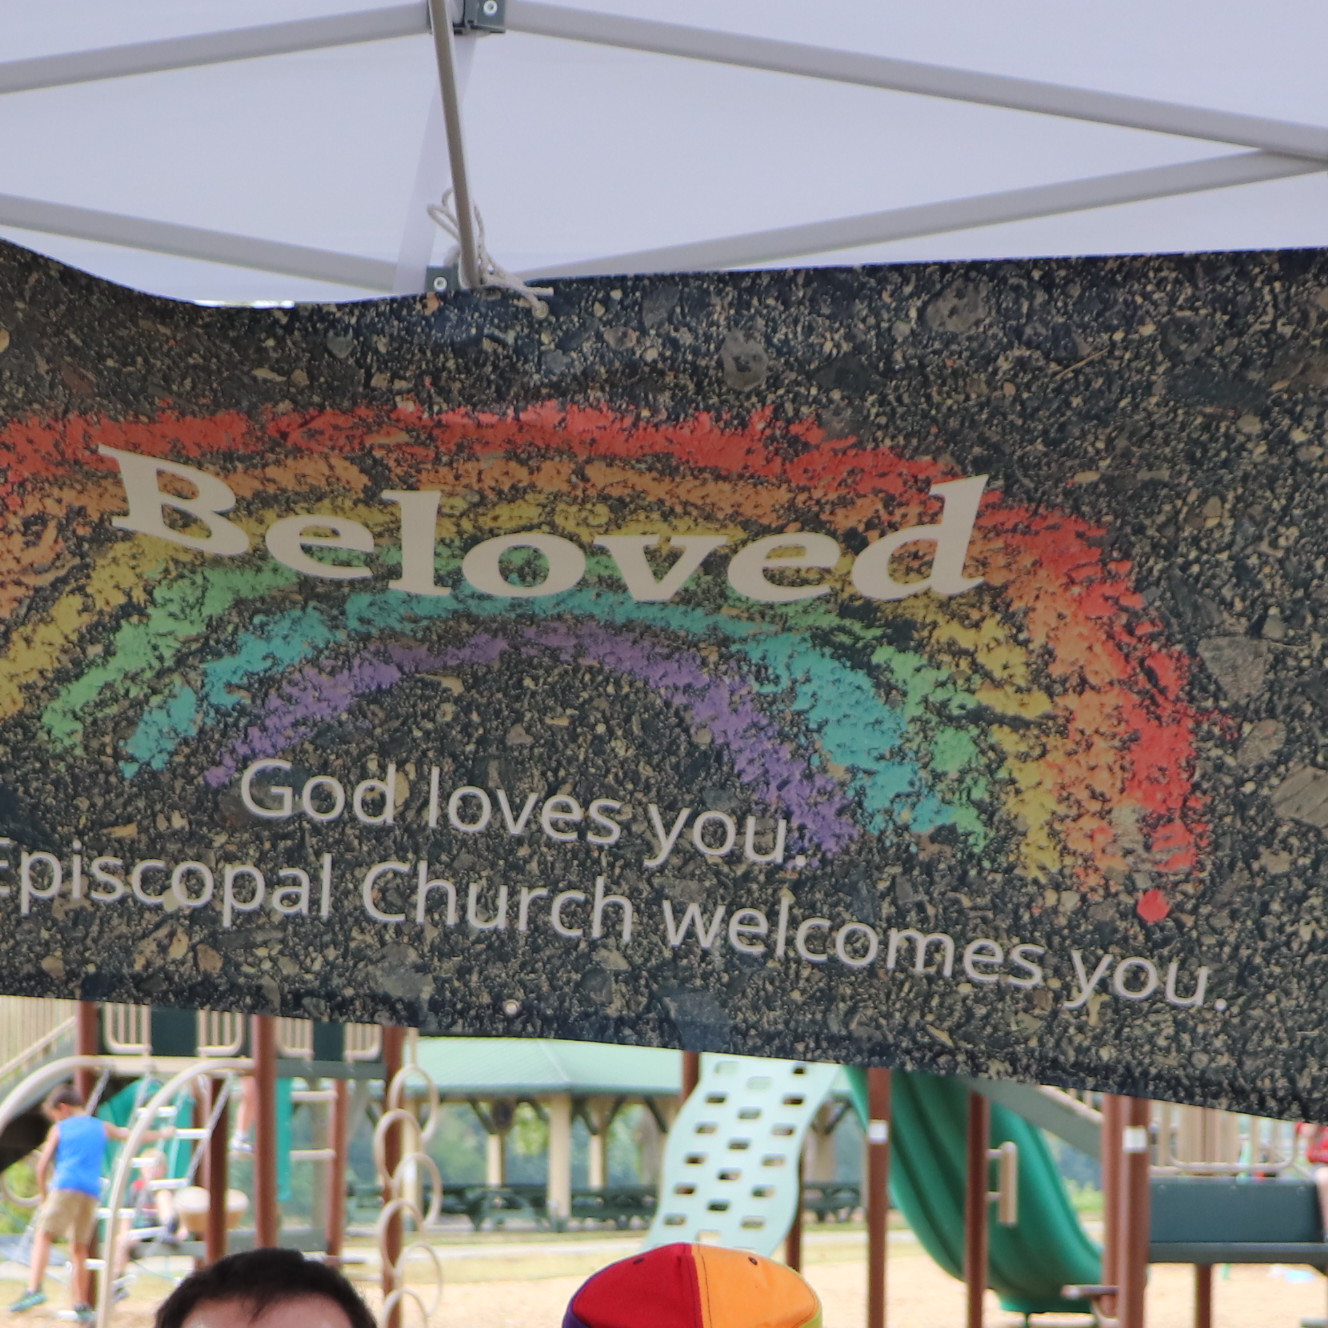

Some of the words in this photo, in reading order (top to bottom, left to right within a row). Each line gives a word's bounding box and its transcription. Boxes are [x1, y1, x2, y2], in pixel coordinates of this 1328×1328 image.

[97, 443, 990, 600] Beloved
[239, 758, 397, 826] God
[428, 766, 621, 845] loves
[644, 804, 809, 869] you.
[362, 859, 633, 943] Church
[662, 892, 1045, 988] welcomes
[1064, 949, 1228, 1012] you.
